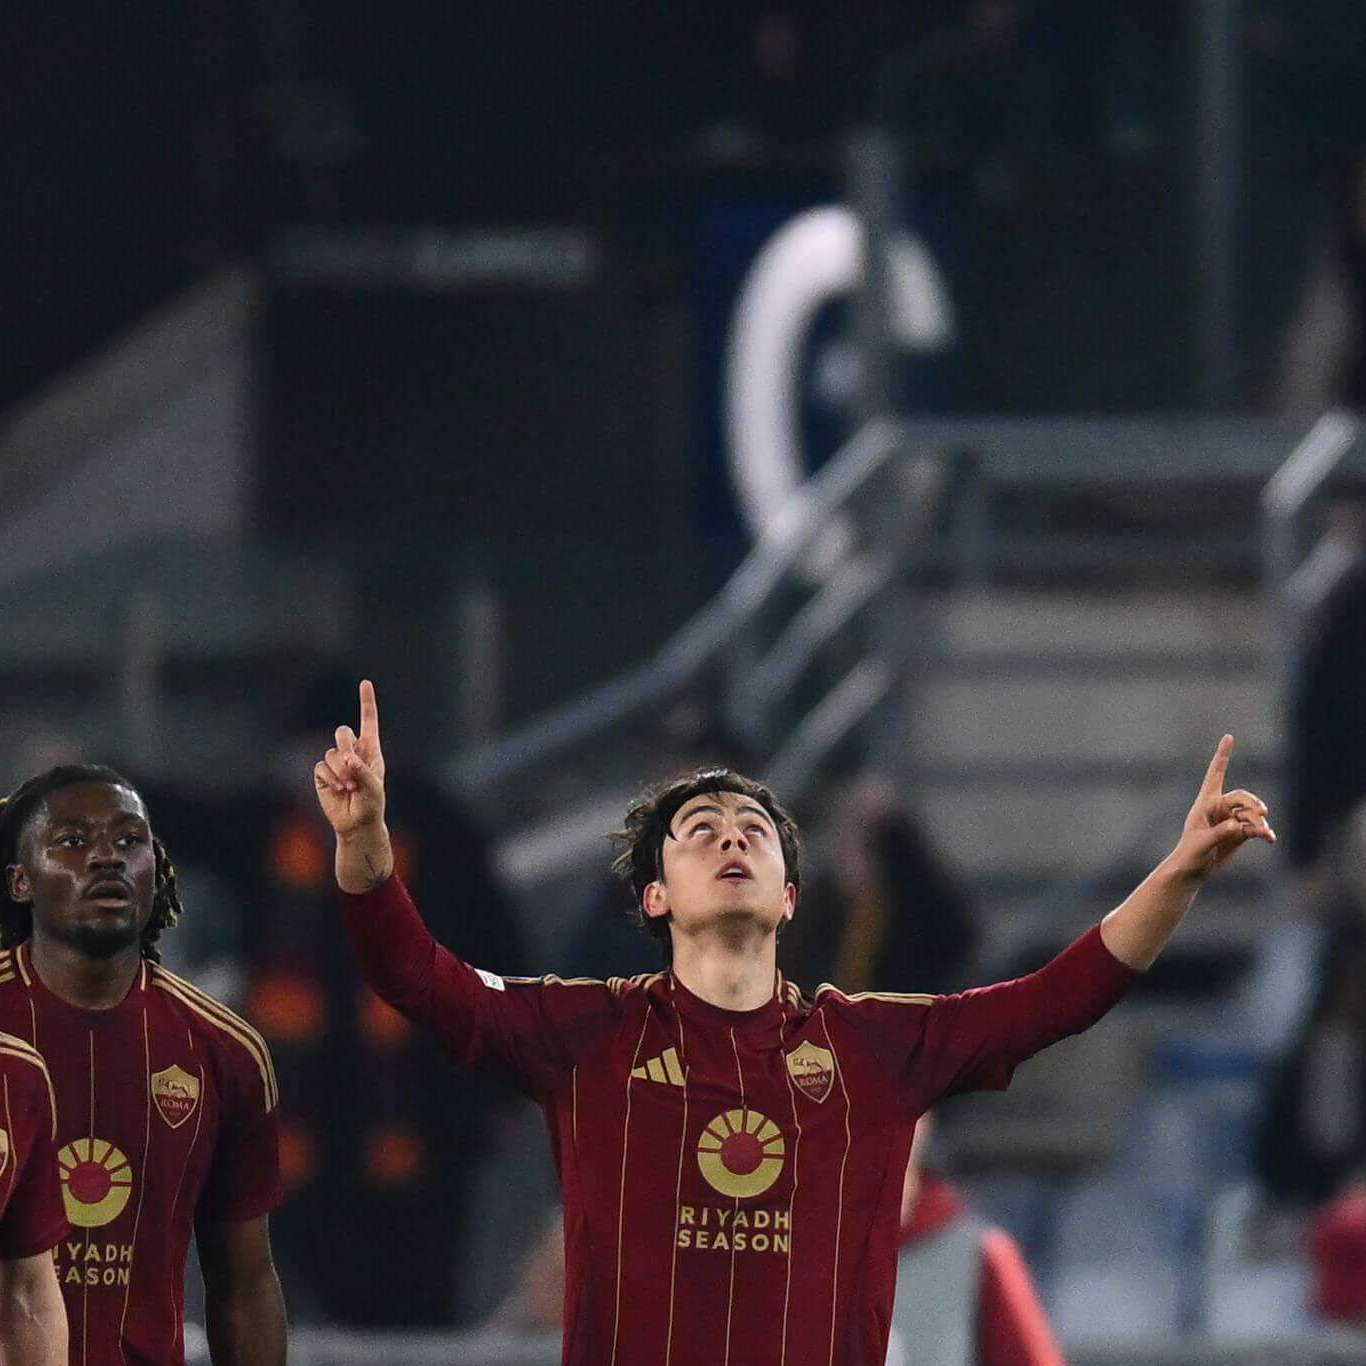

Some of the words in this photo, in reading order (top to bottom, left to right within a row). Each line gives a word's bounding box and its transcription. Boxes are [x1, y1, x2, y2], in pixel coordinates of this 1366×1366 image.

[680, 1206, 790, 1230] RIYADH
[52, 1242, 133, 1262] IYADH
[677, 1229, 789, 1253] SEASON
[54, 1264, 131, 1286] ASON
